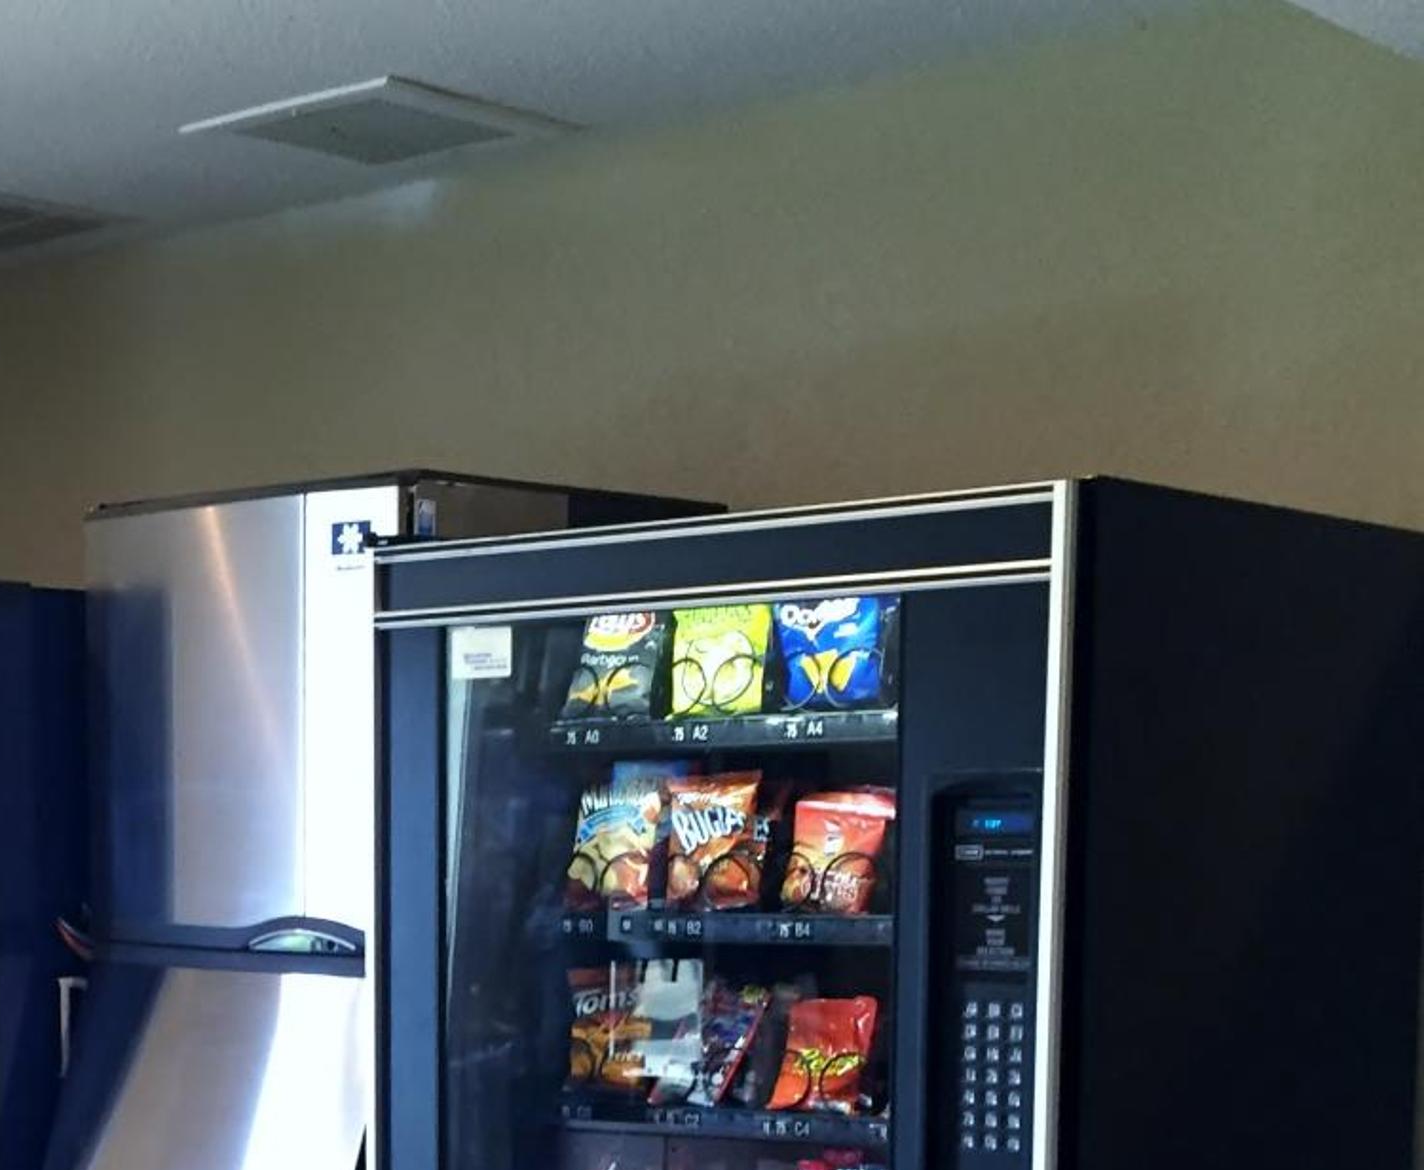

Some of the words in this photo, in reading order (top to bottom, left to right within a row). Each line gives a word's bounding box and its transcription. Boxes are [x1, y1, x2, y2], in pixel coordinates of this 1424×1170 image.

[693, 724, 708, 741] A2
[807, 720, 823, 736] A4
[686, 920, 701, 935] B2
[795, 1121, 810, 1137] C4
